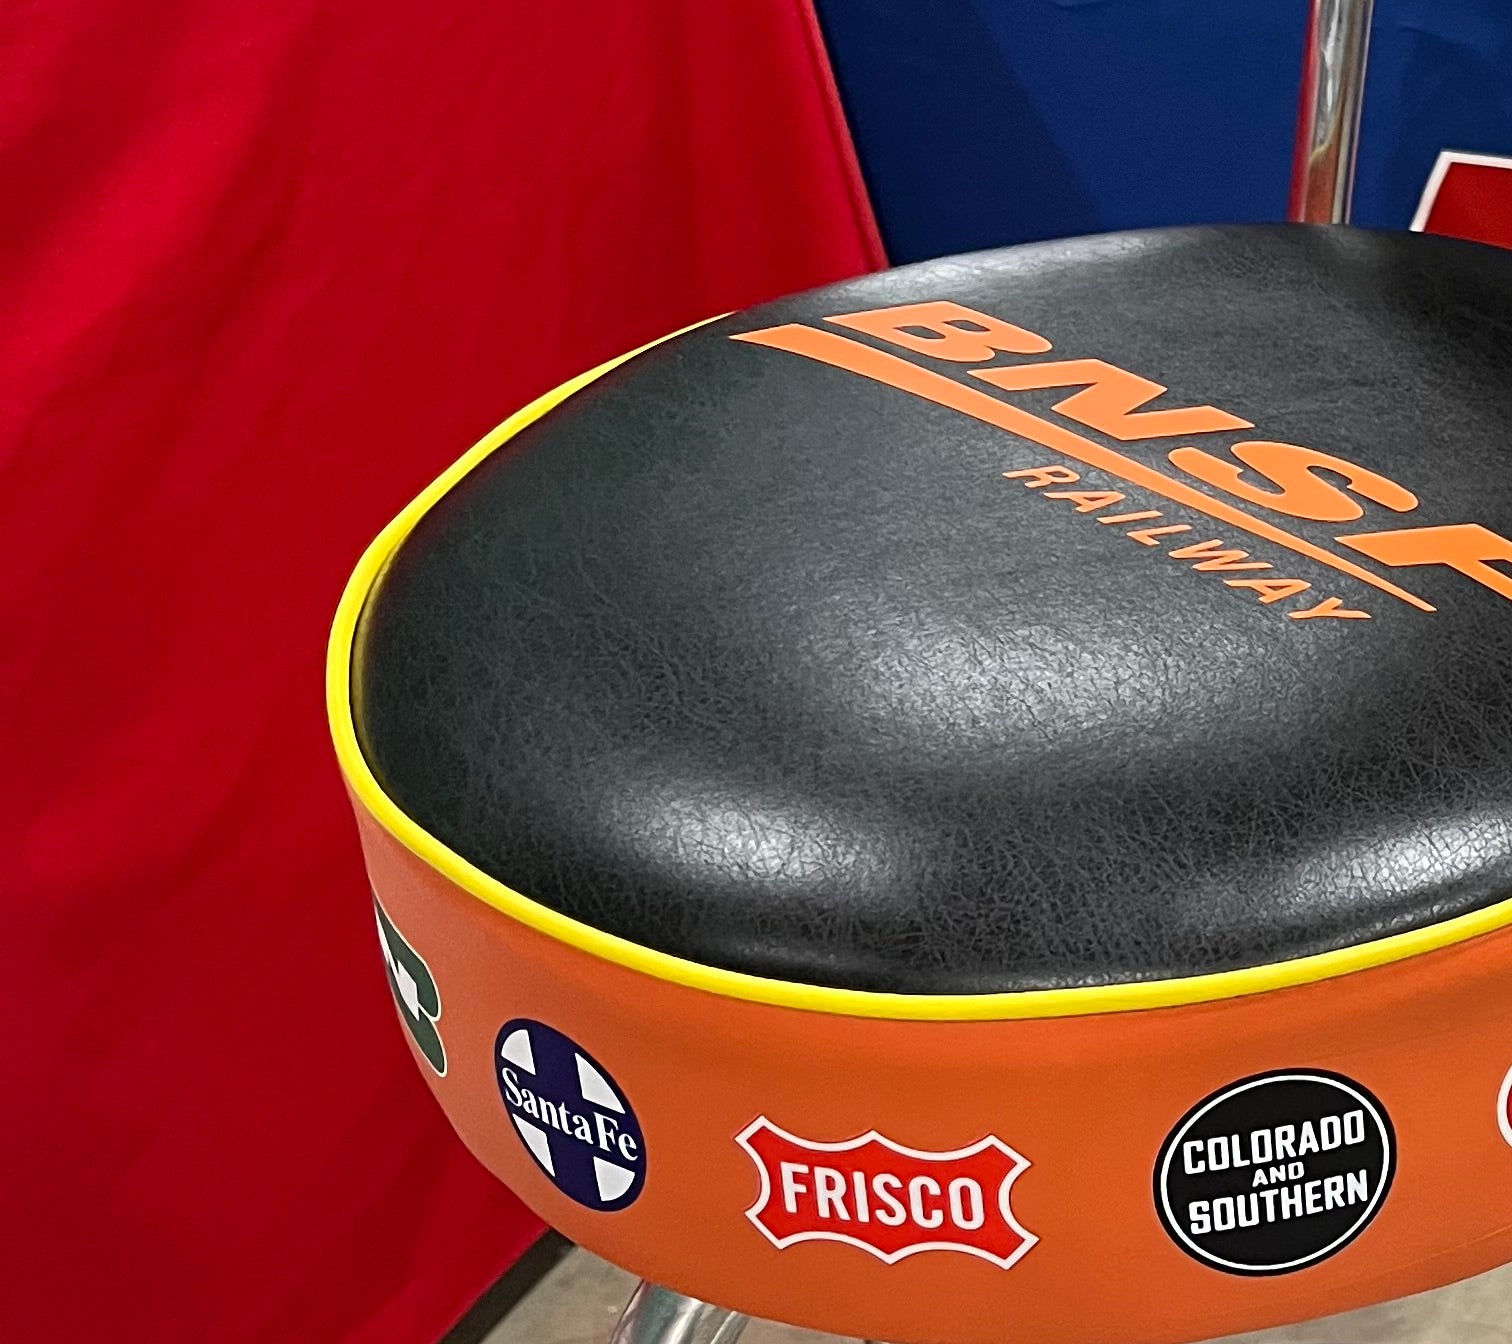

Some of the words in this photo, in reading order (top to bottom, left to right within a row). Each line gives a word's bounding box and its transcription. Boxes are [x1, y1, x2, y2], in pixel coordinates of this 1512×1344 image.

[1002, 465, 1372, 620] RAILWAY
[501, 1067, 594, 1145] Santa
[593, 1111, 639, 1162] Fe
[1182, 1109, 1366, 1176] COLORADO
[779, 1162, 985, 1230] FRISCO
[1188, 1168, 1369, 1236] SOUTHERN
[1251, 1160, 1306, 1188] AND
